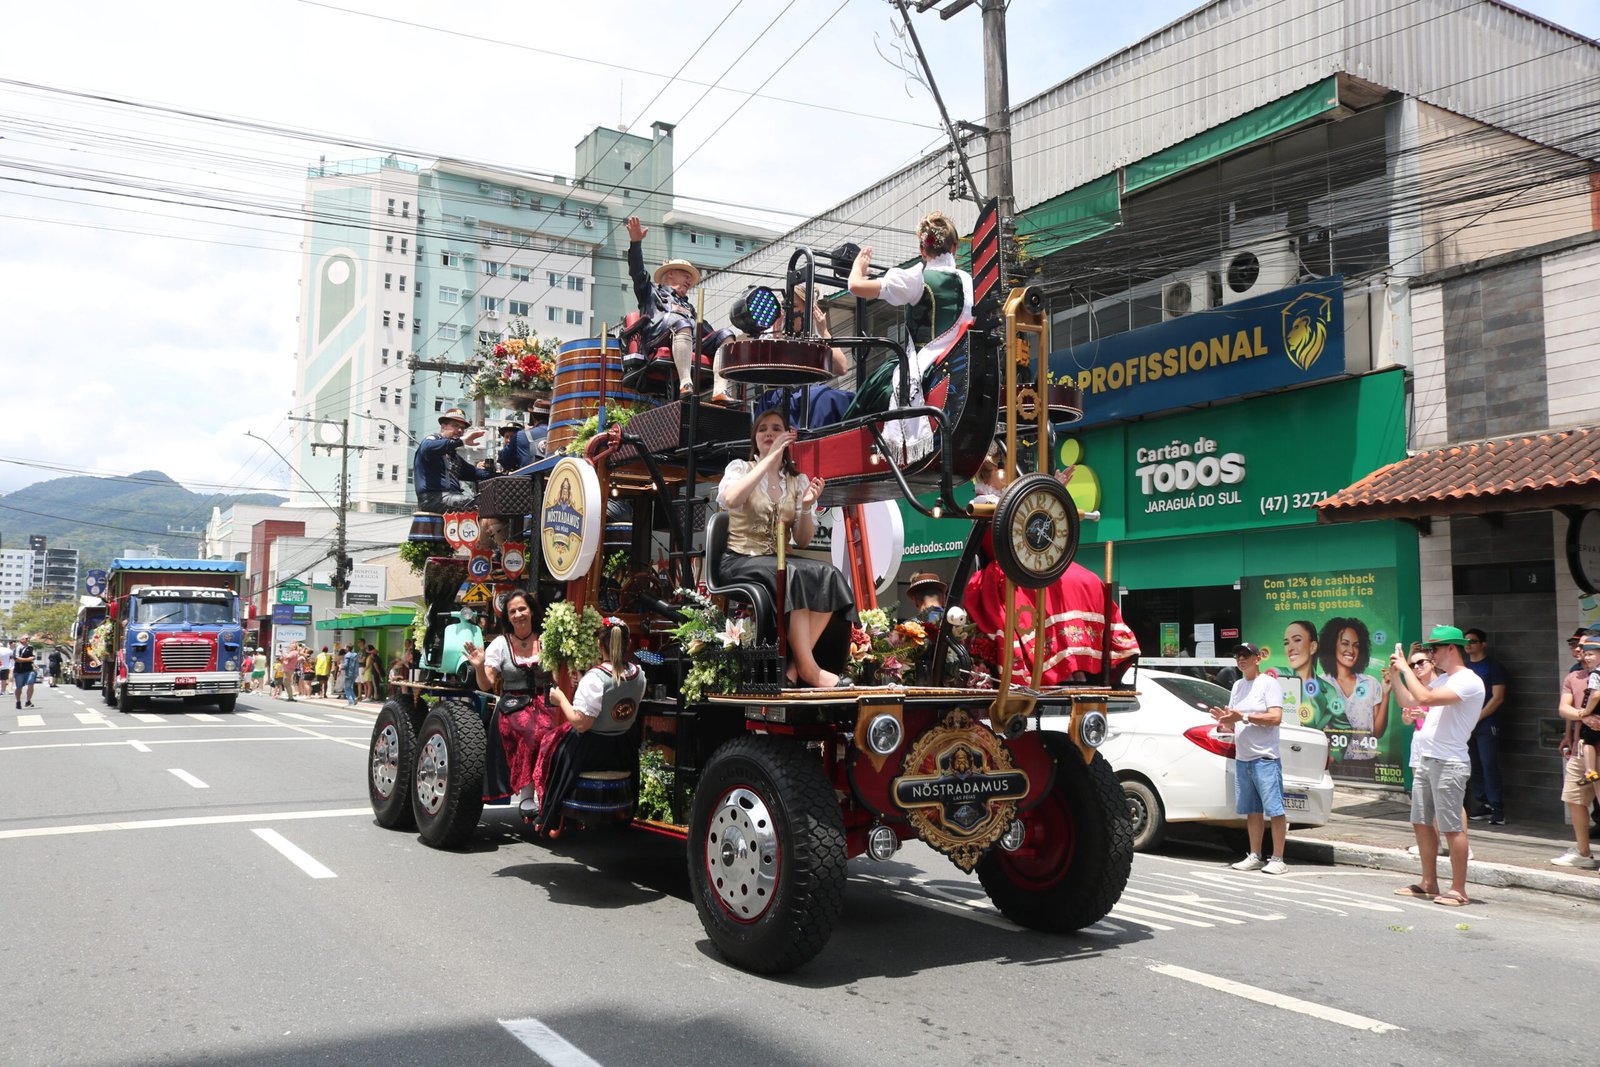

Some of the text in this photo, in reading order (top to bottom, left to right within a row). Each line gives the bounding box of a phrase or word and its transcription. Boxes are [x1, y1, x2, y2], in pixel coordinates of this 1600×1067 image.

[1077, 326, 1269, 394] PROFISSIONAL
[1137, 436, 1217, 463] Cartão de
[1135, 452, 1246, 495] TODOS
[1145, 491, 1242, 513] JARAGUÁ DO SUL
[1260, 490, 1328, 515] (47) 3271
[462, 529, 476, 538] brt
[1264, 573, 1375, 589] Com 12% de cashback
[1266, 592, 1277, 600] no
[1280, 589, 1300, 601] gás,
[1302, 590, 1309, 598] a
[1311, 587, 1347, 598] comida
[1274, 599, 1364, 612] até mais gostosa.
[1331, 734, 1348, 747] 30
[1359, 736, 1378, 749] 40
[1378, 767, 1402, 777] TUDO
[1284, 798, 1306, 809] ZE3C27
